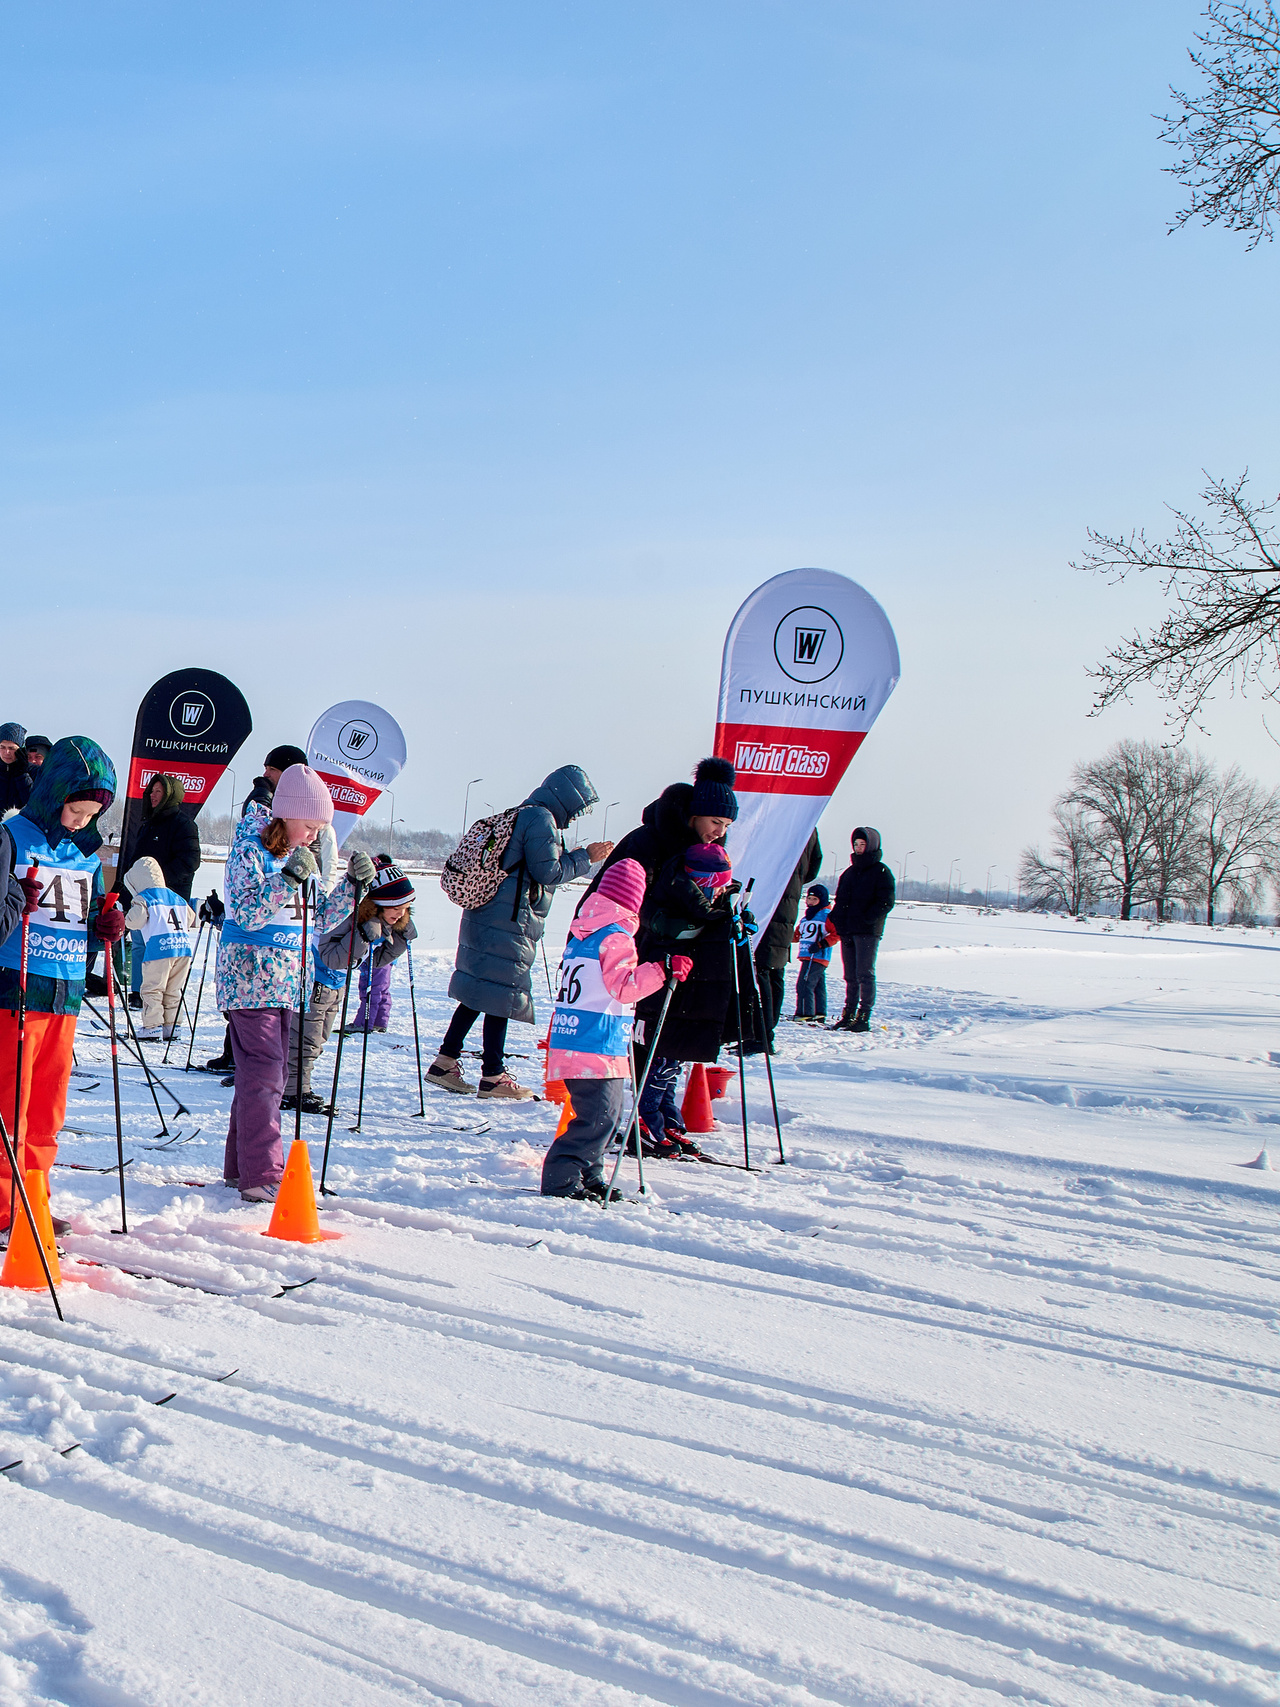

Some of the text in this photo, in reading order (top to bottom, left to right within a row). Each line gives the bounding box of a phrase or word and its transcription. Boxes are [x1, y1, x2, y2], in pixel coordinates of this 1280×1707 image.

[798, 632, 820, 660] W
[740, 689, 866, 711] ПУШКИНСКИЙ
[185, 706, 200, 723] W
[145, 738, 228, 753] ПУШКИНСКИЙ
[352, 732, 367, 750] W
[315, 752, 385, 782] ПУШКИНСКИЙ
[737, 746, 827, 775] World Class
[339, 788, 366, 805] Class
[37, 874, 89, 925] 41
[167, 908, 184, 931] 4
[26, 946, 75, 962] OUTDOOR
[556, 964, 585, 1004] 46
[557, 1026, 577, 1036] TEAM
